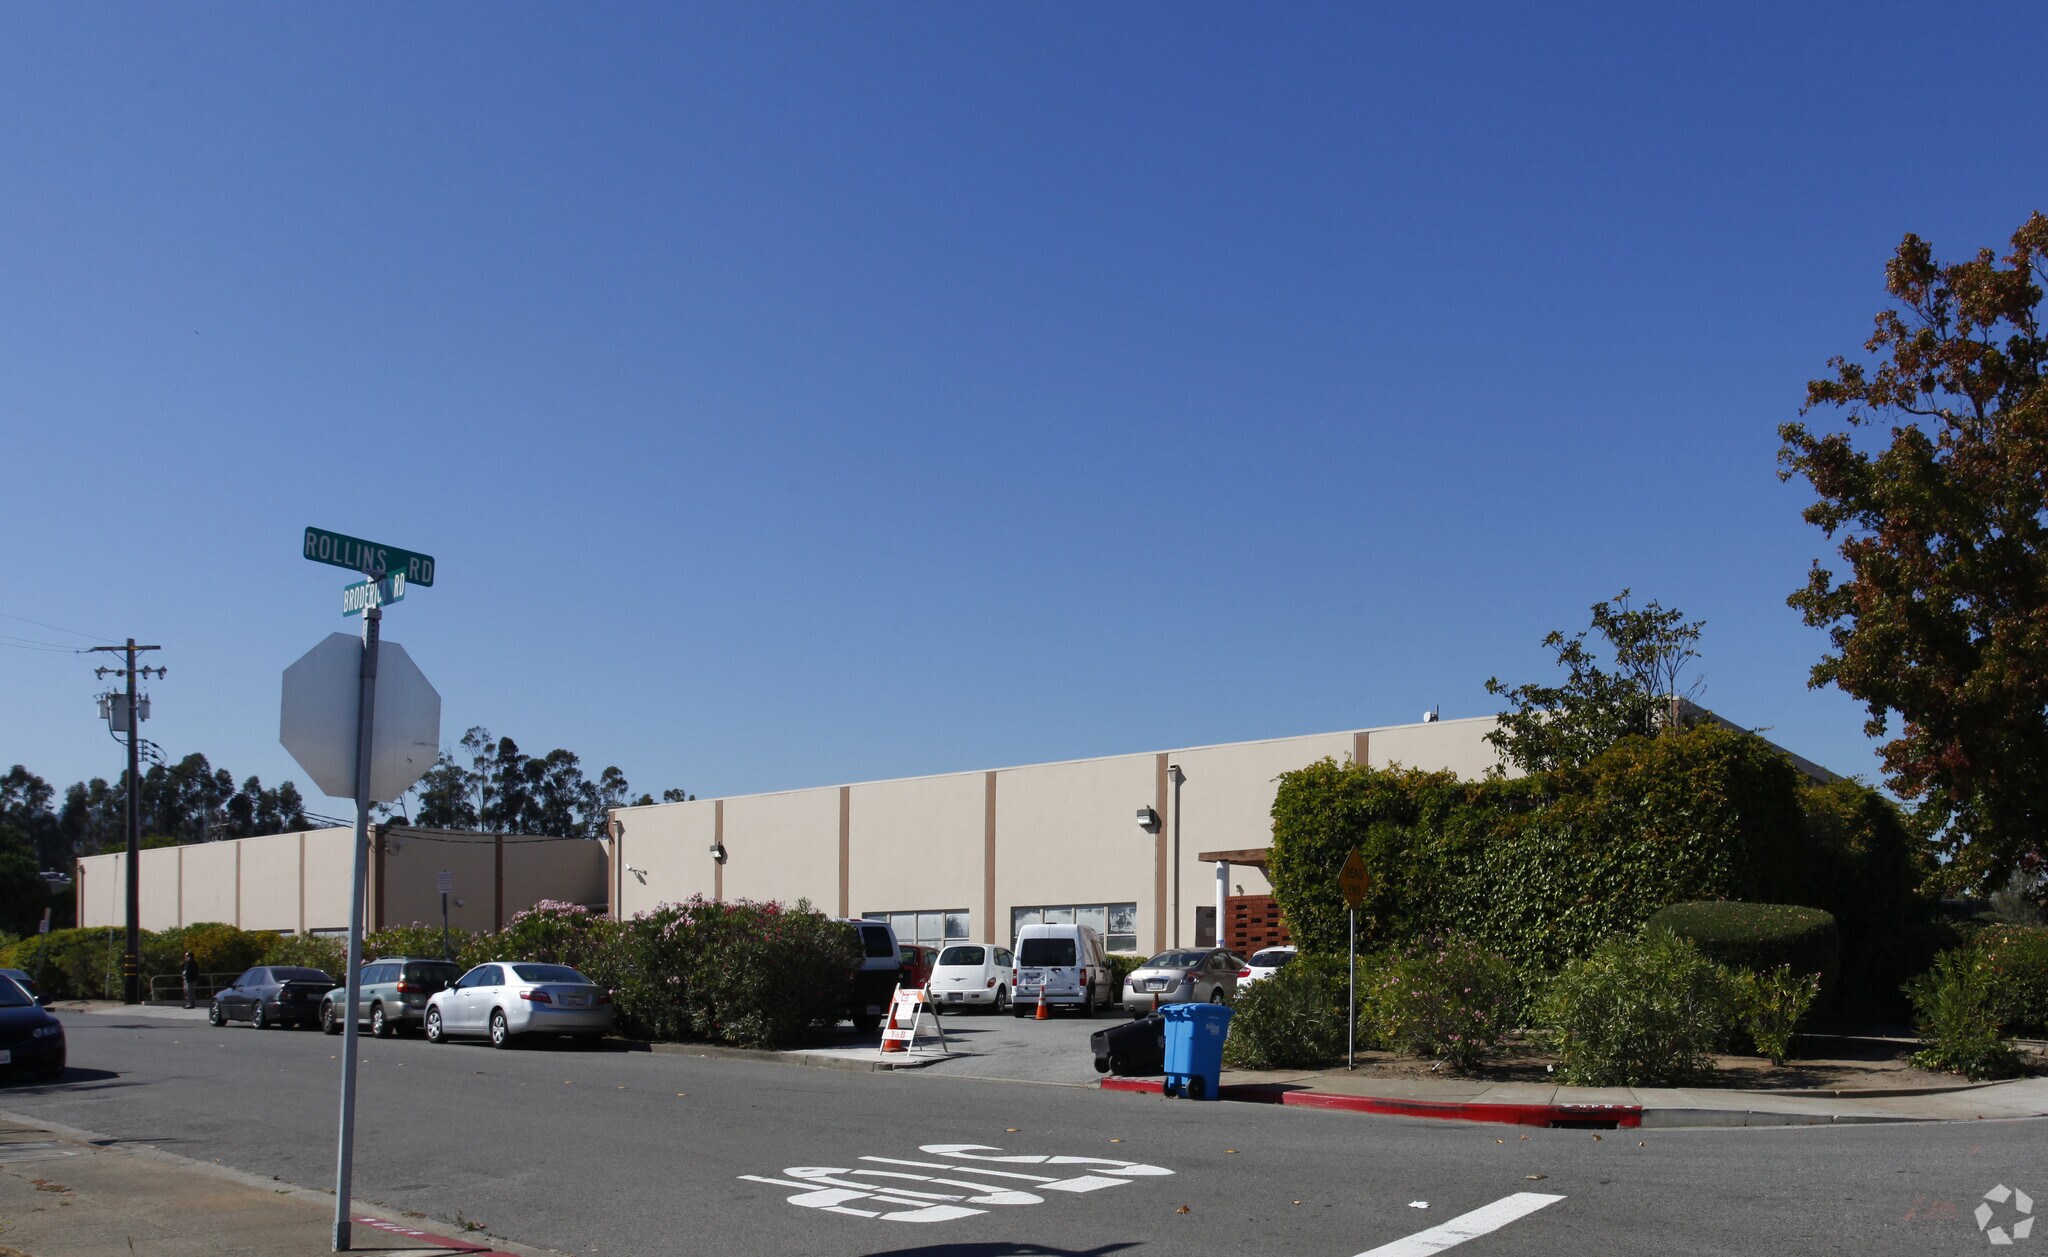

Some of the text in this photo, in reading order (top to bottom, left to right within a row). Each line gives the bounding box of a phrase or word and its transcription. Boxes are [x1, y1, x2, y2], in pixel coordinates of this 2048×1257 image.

[305, 532, 432, 583] ROLLINS RD
[343, 572, 405, 613] BRODERIC RD
[1345, 867, 1363, 879] DEAD
[1348, 884, 1361, 896] END
[736, 1144, 1176, 1223] STOP
